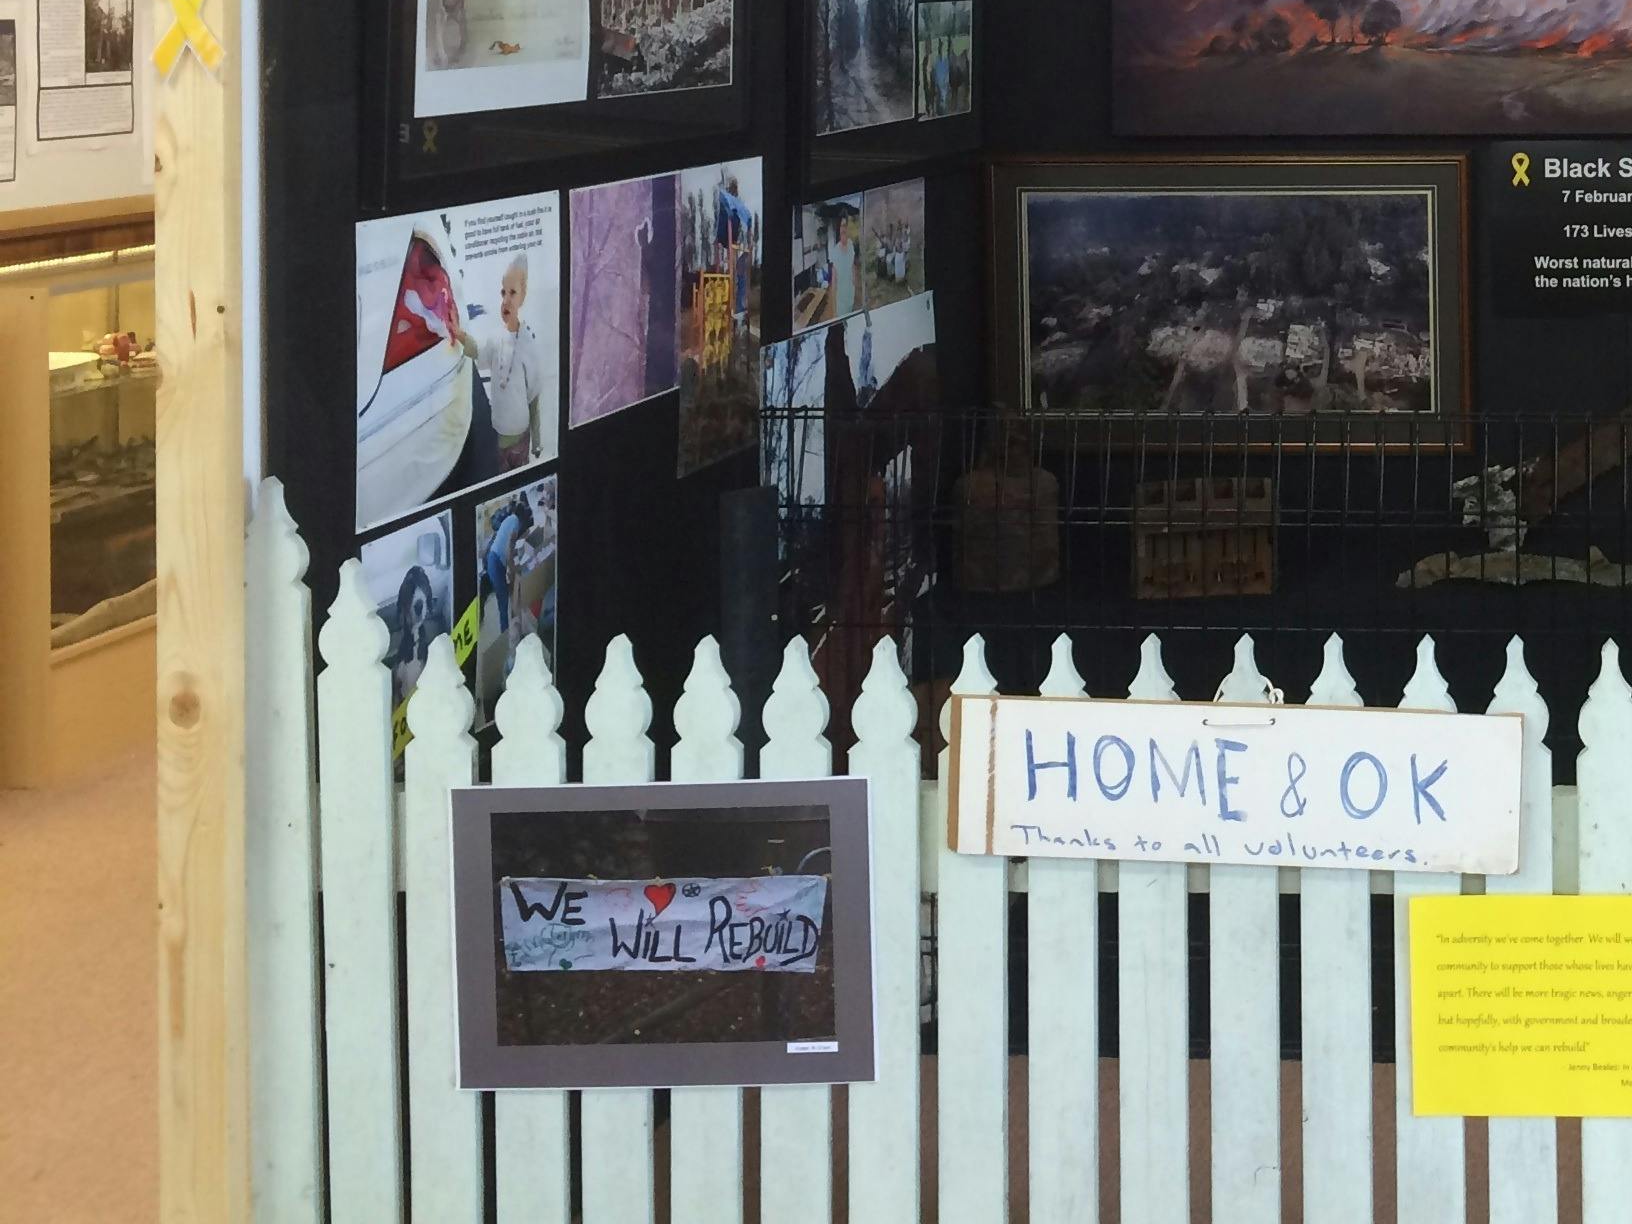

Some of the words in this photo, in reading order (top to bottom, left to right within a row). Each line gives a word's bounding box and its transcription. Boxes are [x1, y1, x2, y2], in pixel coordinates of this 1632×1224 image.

[1544, 157, 1611, 178] Black
[1562, 190, 1571, 202] 7
[1564, 225, 1589, 237] 173
[1594, 225, 1632, 237] Lives
[1534, 256, 1578, 268] Worst
[1535, 276, 1558, 287] the
[1563, 276, 1622, 287] nation's
[1024, 728, 1249, 822] HOME
[1280, 752, 1308, 818] &
[1339, 750, 1449, 825] OK
[1010, 824, 1116, 854] Thanks
[1134, 834, 1163, 854] to
[1184, 834, 1220, 858] all
[1244, 832, 1429, 867] volunteers.
[509, 881, 589, 926] WE
[609, 908, 697, 963] WILL
[704, 895, 822, 967] REBUILD
[1436, 933, 1450, 944] "In
[1452, 934, 1492, 948] adversity
[1495, 933, 1518, 944] we've
[1520, 936, 1544, 944] come
[1588, 934, 1603, 944] We
[1605, 934, 1621, 944] will
[1437, 960, 1488, 975] community
[1490, 961, 1499, 971] to
[1502, 961, 1537, 976] support
[1539, 960, 1563, 971] those
[1565, 960, 1593, 971] whose
[1595, 960, 1614, 971] lives
[1438, 988, 1464, 1001] apart.
[1467, 988, 1492, 998] There
[1495, 988, 1510, 998] will
[1513, 988, 1523, 998] be
[1525, 990, 1548, 998] more
[1551, 988, 1577, 1001] tragic
[1579, 990, 1604, 999] news,
[1607, 990, 1632, 1001] anger
[1439, 1015, 1453, 1026] but
[1456, 1015, 1500, 1028] hopefully,
[1503, 1015, 1522, 1026] with
[1524, 1015, 1578, 1029] government
[1580, 1015, 1598, 1026] and
[1439, 1042, 1496, 1056] community's
[1498, 1042, 1518, 1056] help
[1520, 1044, 1532, 1053] we
[1534, 1044, 1550, 1053] can
[1553, 1042, 1590, 1053] rebuild"
